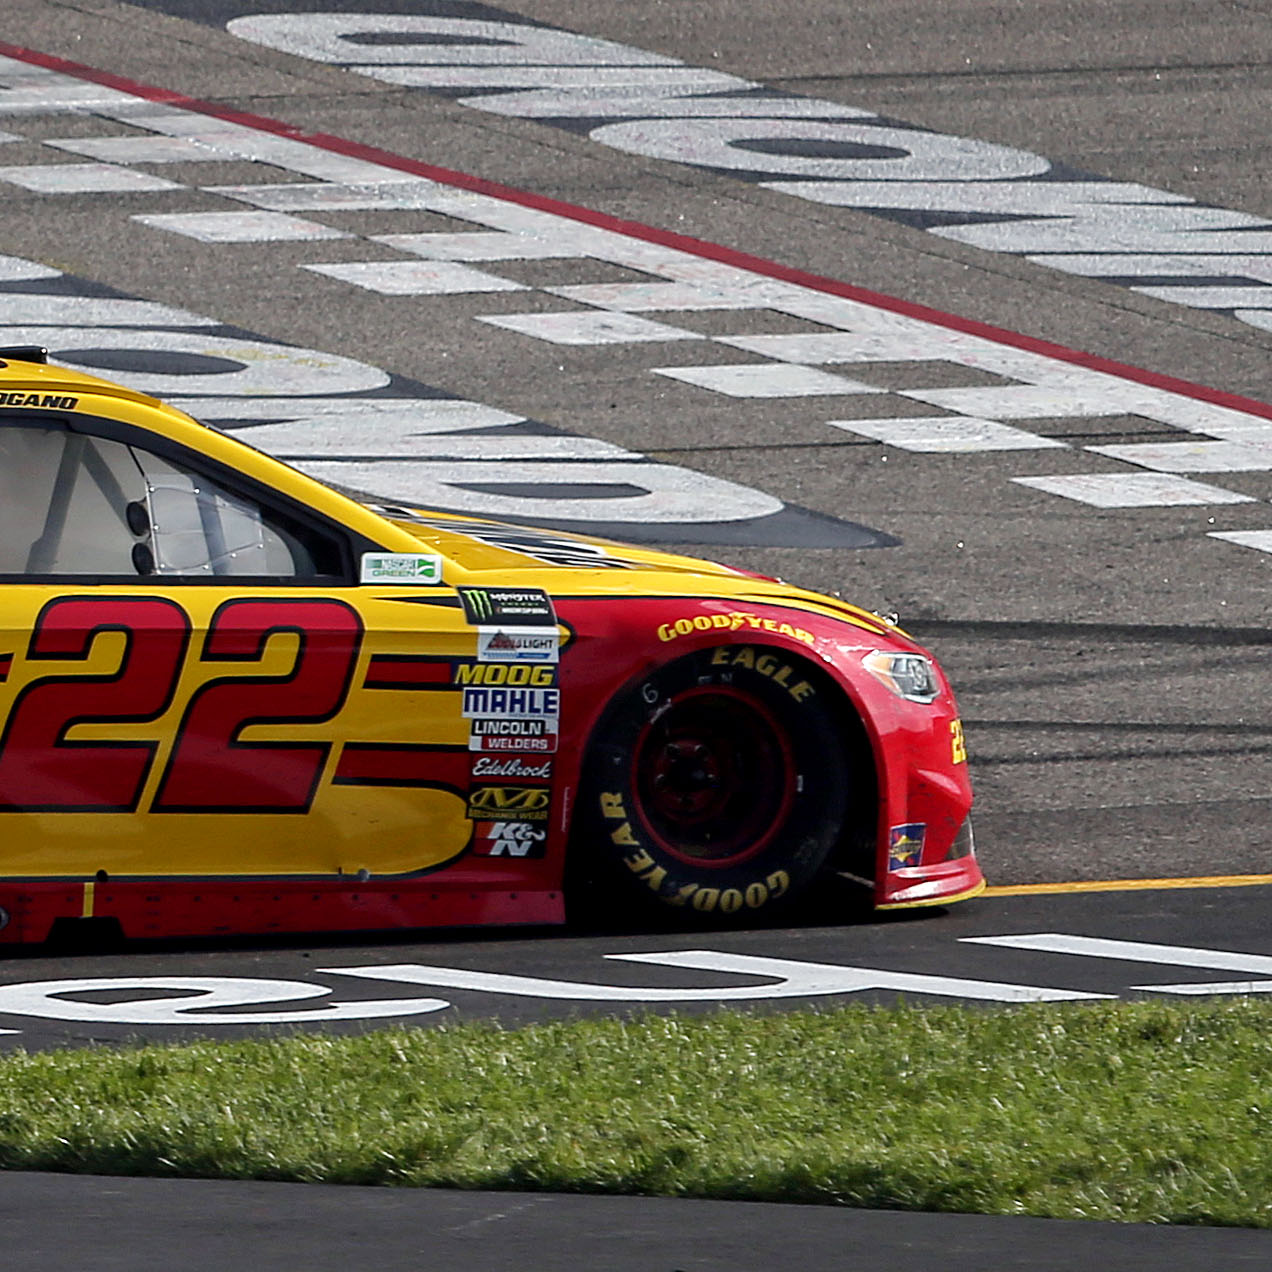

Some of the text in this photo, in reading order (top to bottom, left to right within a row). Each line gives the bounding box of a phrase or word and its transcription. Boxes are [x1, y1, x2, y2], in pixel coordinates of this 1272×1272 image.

[372, 570, 416, 578] GREEN
[490, 592, 546, 602] MONSTER
[657, 610, 816, 647] GOODYEAR
[522, 639, 554, 649] LIGHT
[455, 664, 556, 685] MOOG
[710, 645, 818, 704] EAGLE
[463, 689, 558, 714] MAHLE
[474, 720, 542, 735] LINCOLN
[487, 737, 548, 750] WELDERS
[472, 757, 551, 778] Edelbrock
[598, 790, 791, 913] GOODYEAR
